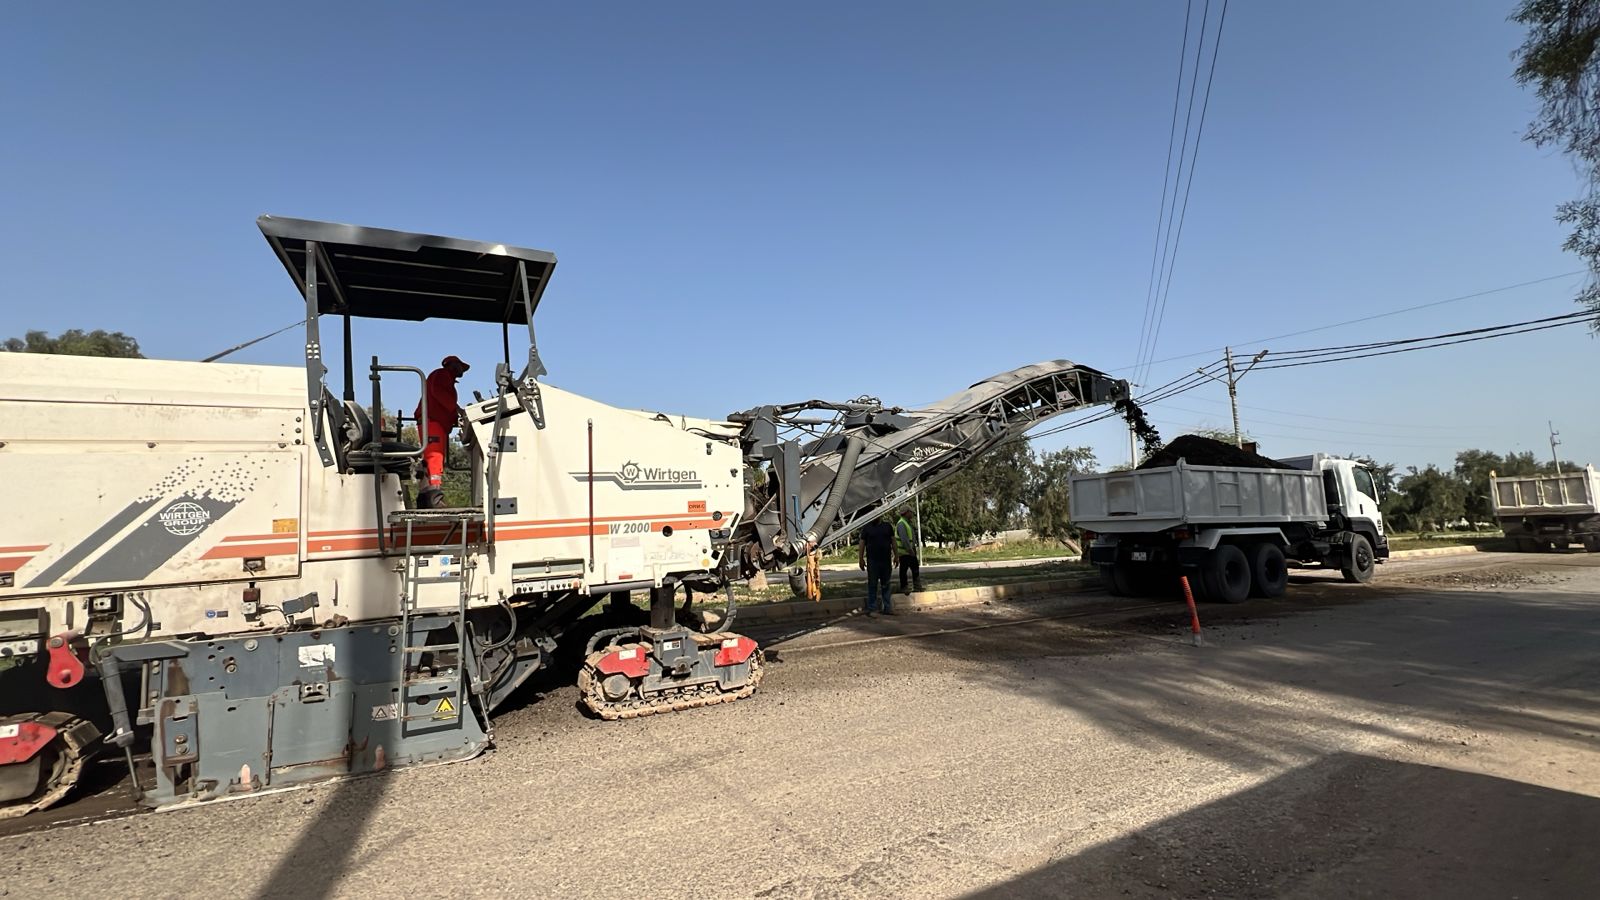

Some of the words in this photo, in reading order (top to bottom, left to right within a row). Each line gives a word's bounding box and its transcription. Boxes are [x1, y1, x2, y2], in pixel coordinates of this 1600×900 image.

[626, 468, 635, 477] W
[643, 467, 697, 483] Wirtgen
[160, 510, 210, 520] WIRTGEN
[610, 523, 621, 534] W
[623, 522, 650, 534] 2000
